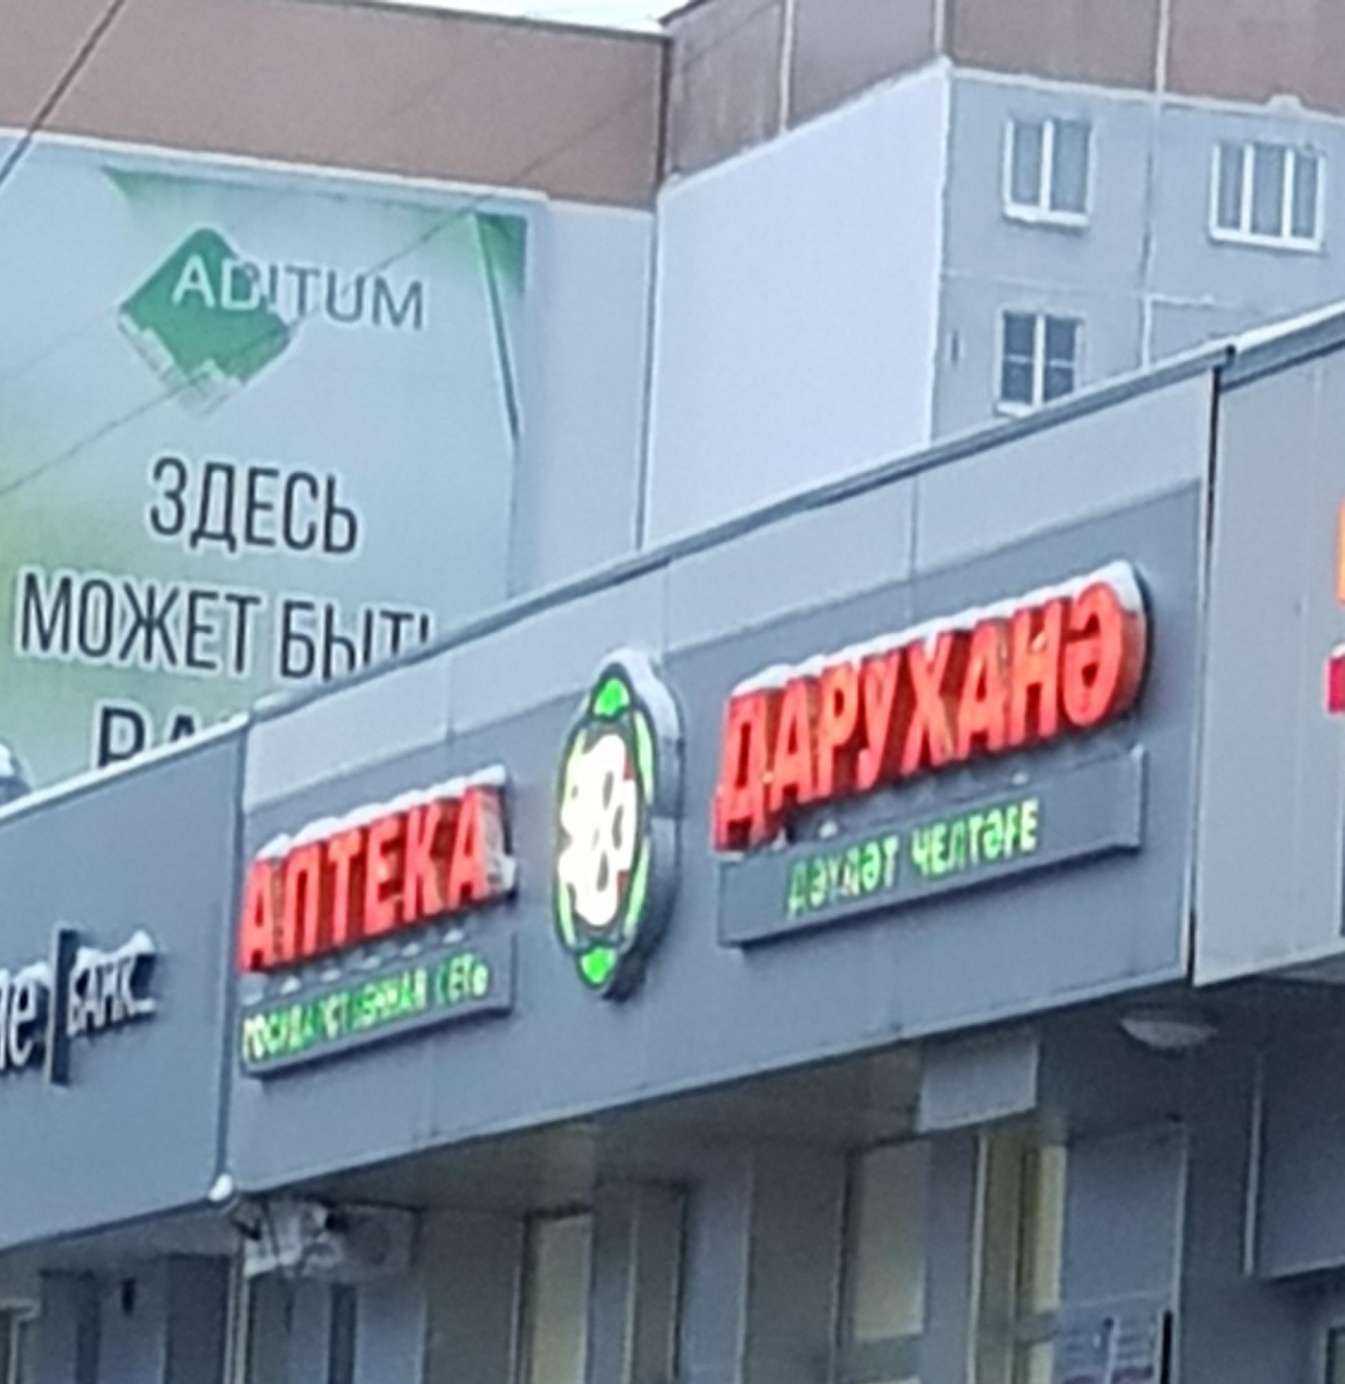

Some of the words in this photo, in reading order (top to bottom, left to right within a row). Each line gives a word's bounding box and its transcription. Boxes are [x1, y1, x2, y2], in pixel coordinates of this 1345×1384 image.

[171, 254, 424, 331] ADITUM
[150, 457, 358, 554] ЗДЕСЬ
[21, 572, 262, 674] МОЖЕТ
[280, 600, 430, 683] БЫТ
[713, 582, 1128, 852] ДАРУХАНӘ
[238, 785, 488, 974] АПТЕКА
